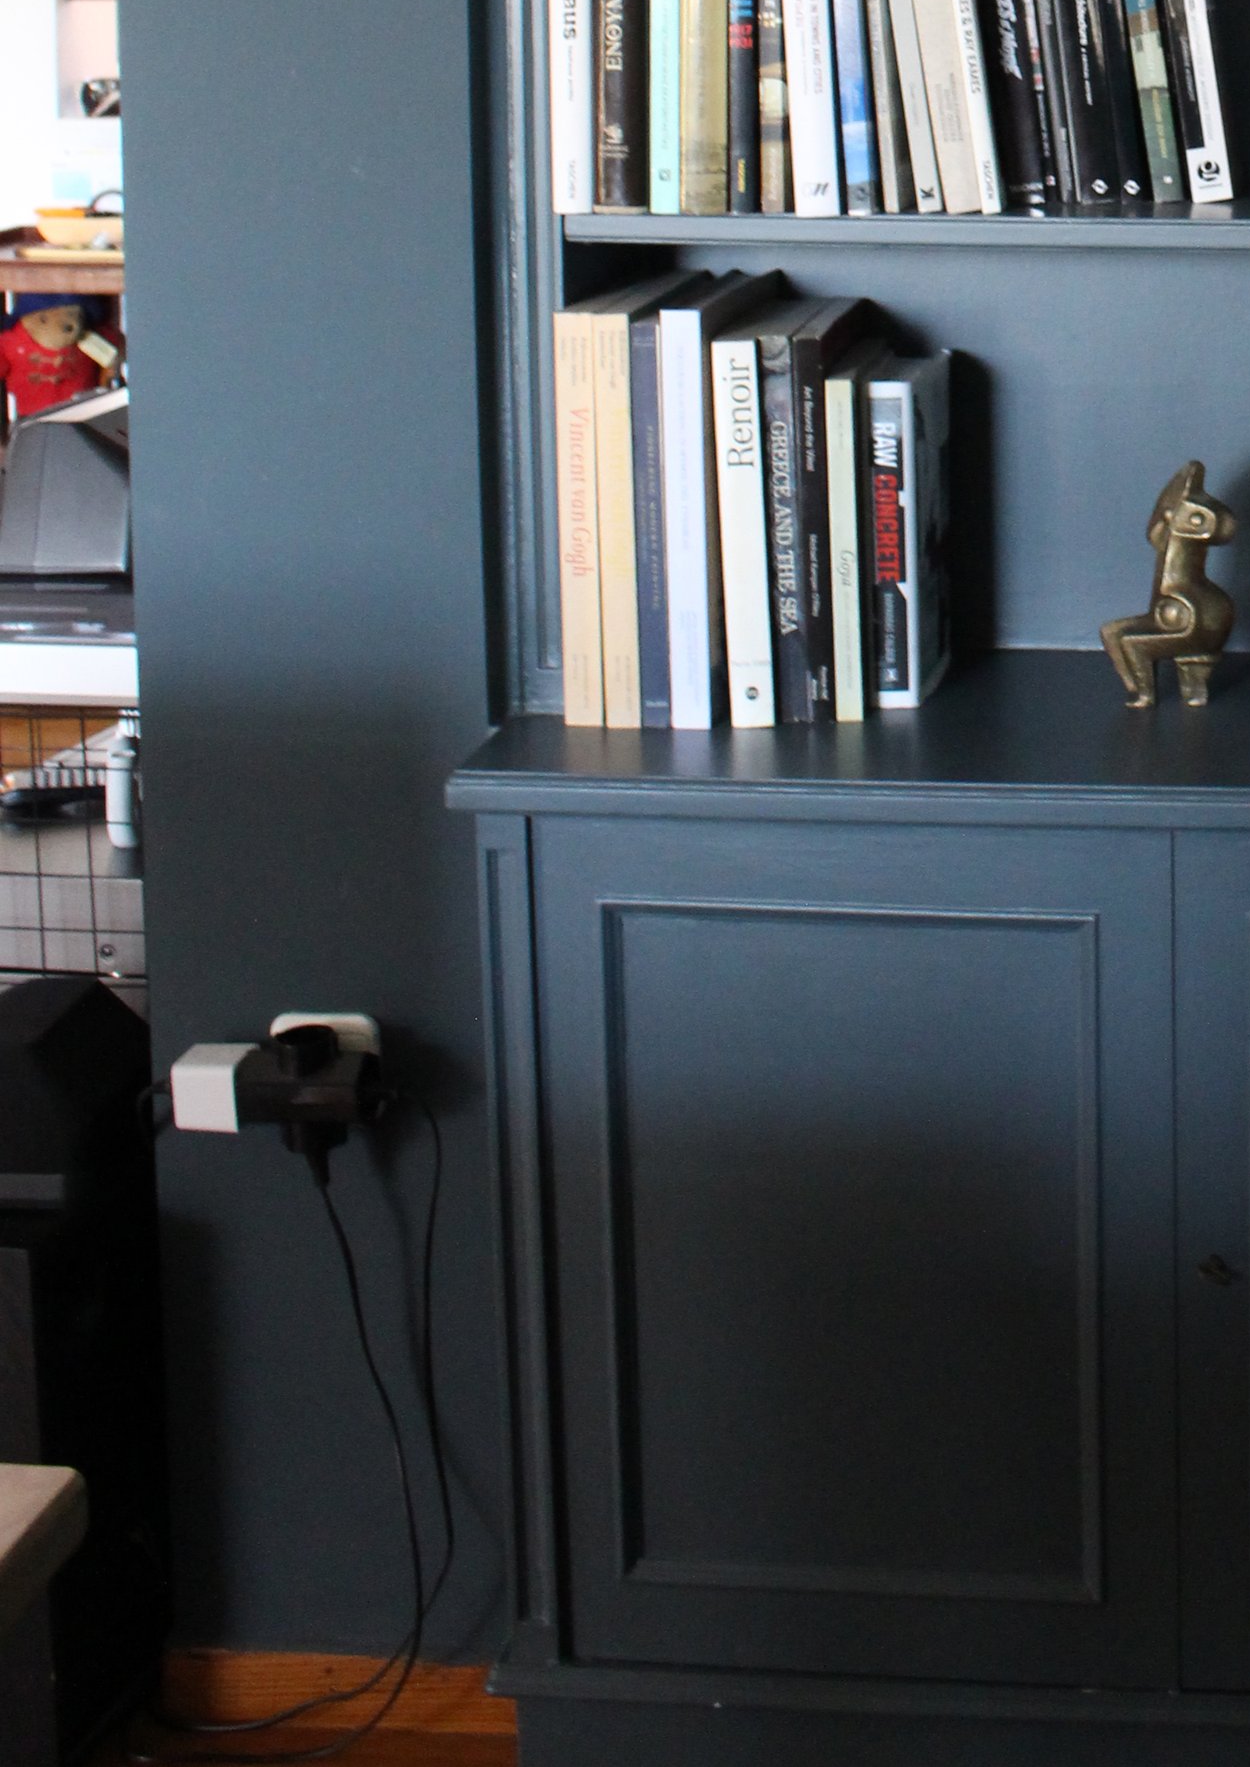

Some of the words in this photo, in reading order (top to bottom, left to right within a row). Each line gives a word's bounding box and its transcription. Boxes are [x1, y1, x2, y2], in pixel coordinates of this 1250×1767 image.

[962, 17, 973, 26] &
[964, 30, 977, 51] RAY
[966, 56, 981, 95] EAMES
[982, 160, 995, 200] TASCHEN
[723, 358, 755, 467] Renoir
[803, 386, 814, 400] Art
[803, 400, 815, 433] Beyond
[569, 406, 593, 484] Vincent
[646, 425, 656, 496] PIONEERING
[769, 421, 791, 498] GREECE
[804, 434, 815, 448] the
[805, 449, 816, 472] West
[872, 421, 898, 467] RAW
[571, 486, 591, 524] van
[612, 486, 631, 524] van
[648, 502, 657, 548] MODERN
[773, 502, 795, 545] AND
[875, 475, 902, 582] CONCRETE
[564, 526, 596, 579] Gogh
[606, 526, 635, 580] Gogh
[775, 550, 797, 593] THE
[837, 551, 855, 587] Goya
[650, 554, 660, 610] PAINTING
[778, 597, 799, 635] SEA
